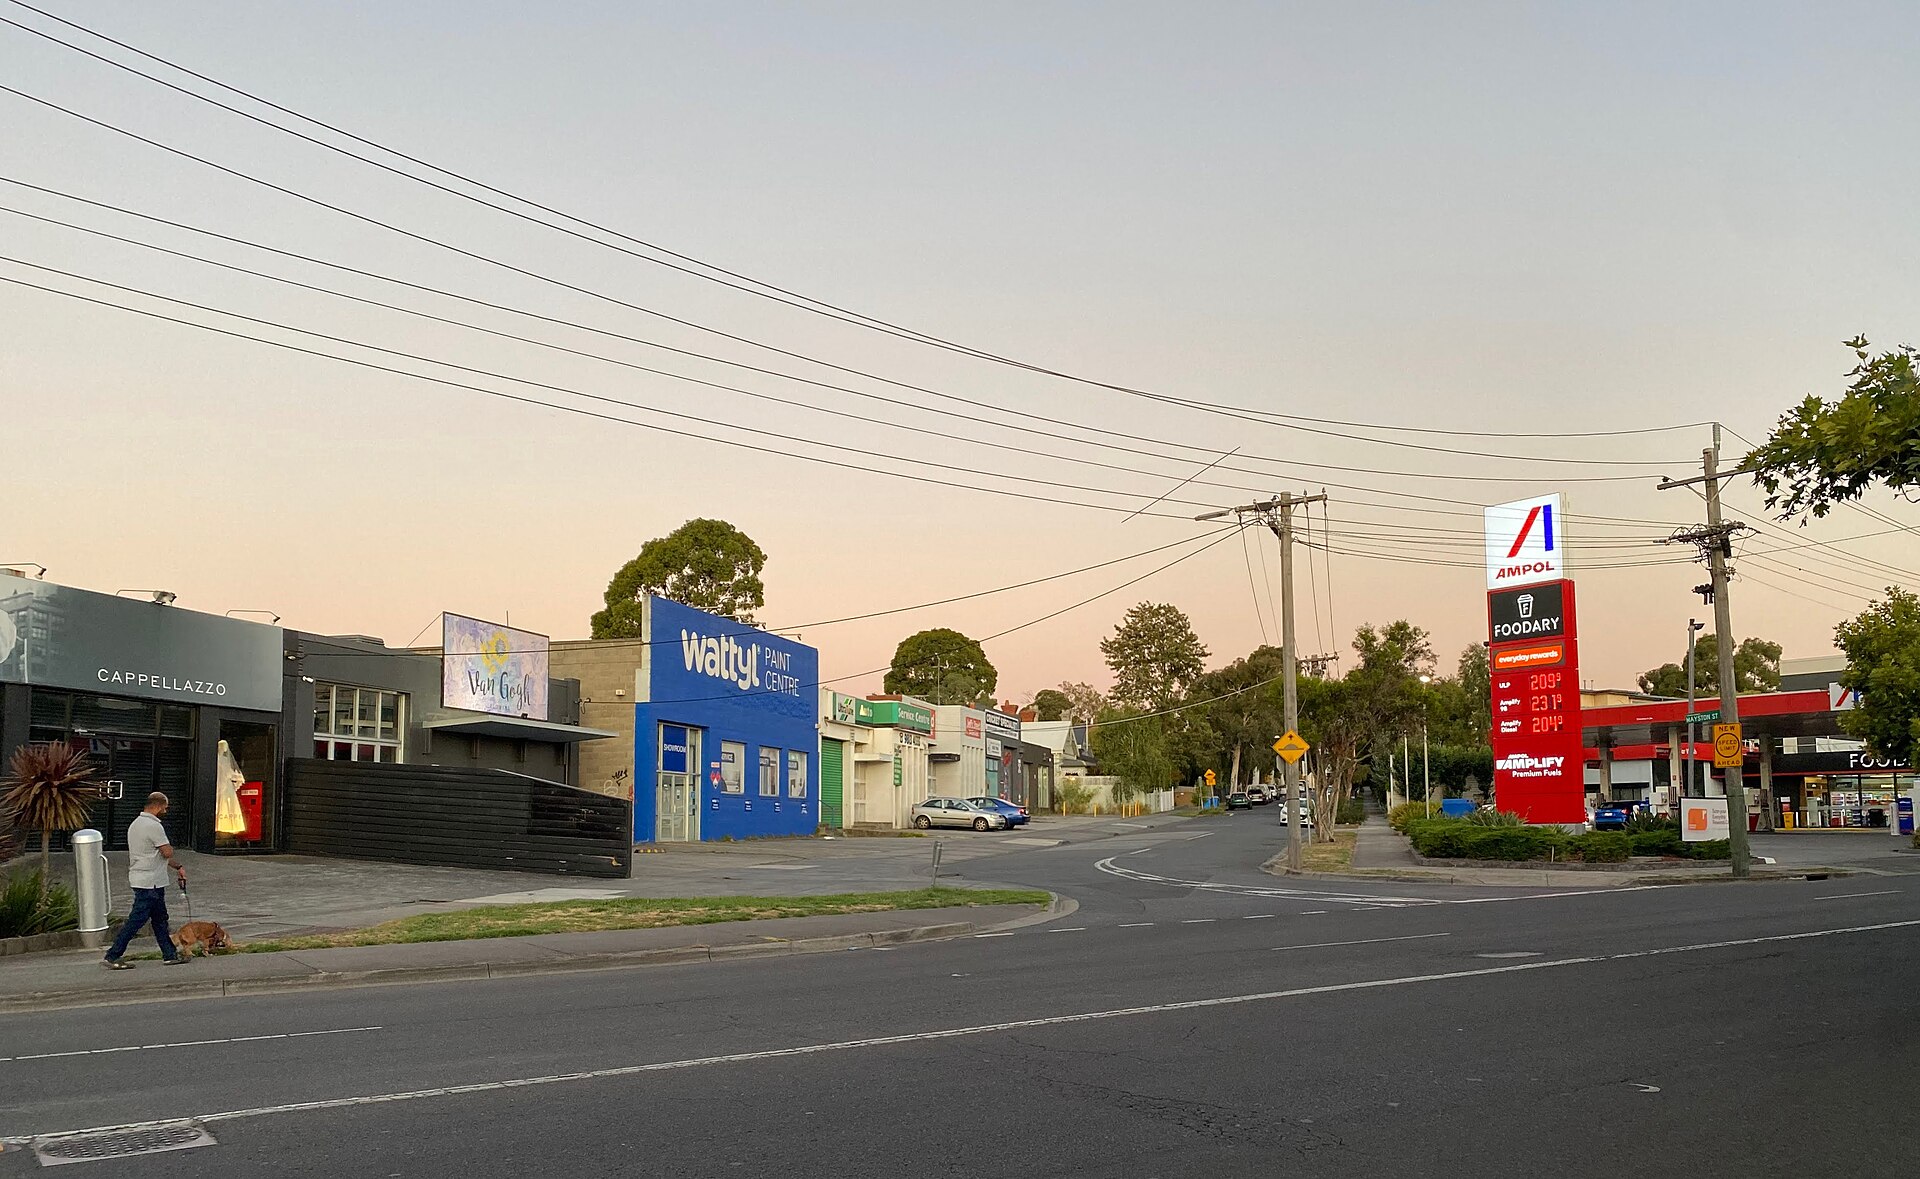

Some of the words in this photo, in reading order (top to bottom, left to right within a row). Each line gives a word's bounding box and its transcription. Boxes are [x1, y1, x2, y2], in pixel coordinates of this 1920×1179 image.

[1495, 561, 1555, 579] AMPOL
[1494, 617, 1560, 637] FOODARY
[681, 628, 760, 690] Wattyl
[765, 647, 791, 672] PAINT
[1498, 653, 1529, 663] everyday
[1530, 650, 1559, 660] rewards
[97, 668, 226, 696] CAPPELLAZZO
[468, 670, 494, 696] Van
[500, 671, 531, 710] Gogh
[765, 670, 800, 697] CENTRE
[898, 707, 914, 721] Service
[915, 711, 930, 725] Centre
[663, 743, 687, 753] SHOWROOM
[1501, 756, 1565, 770] AMPLIFY
[1512, 770, 1543, 778] Premium
